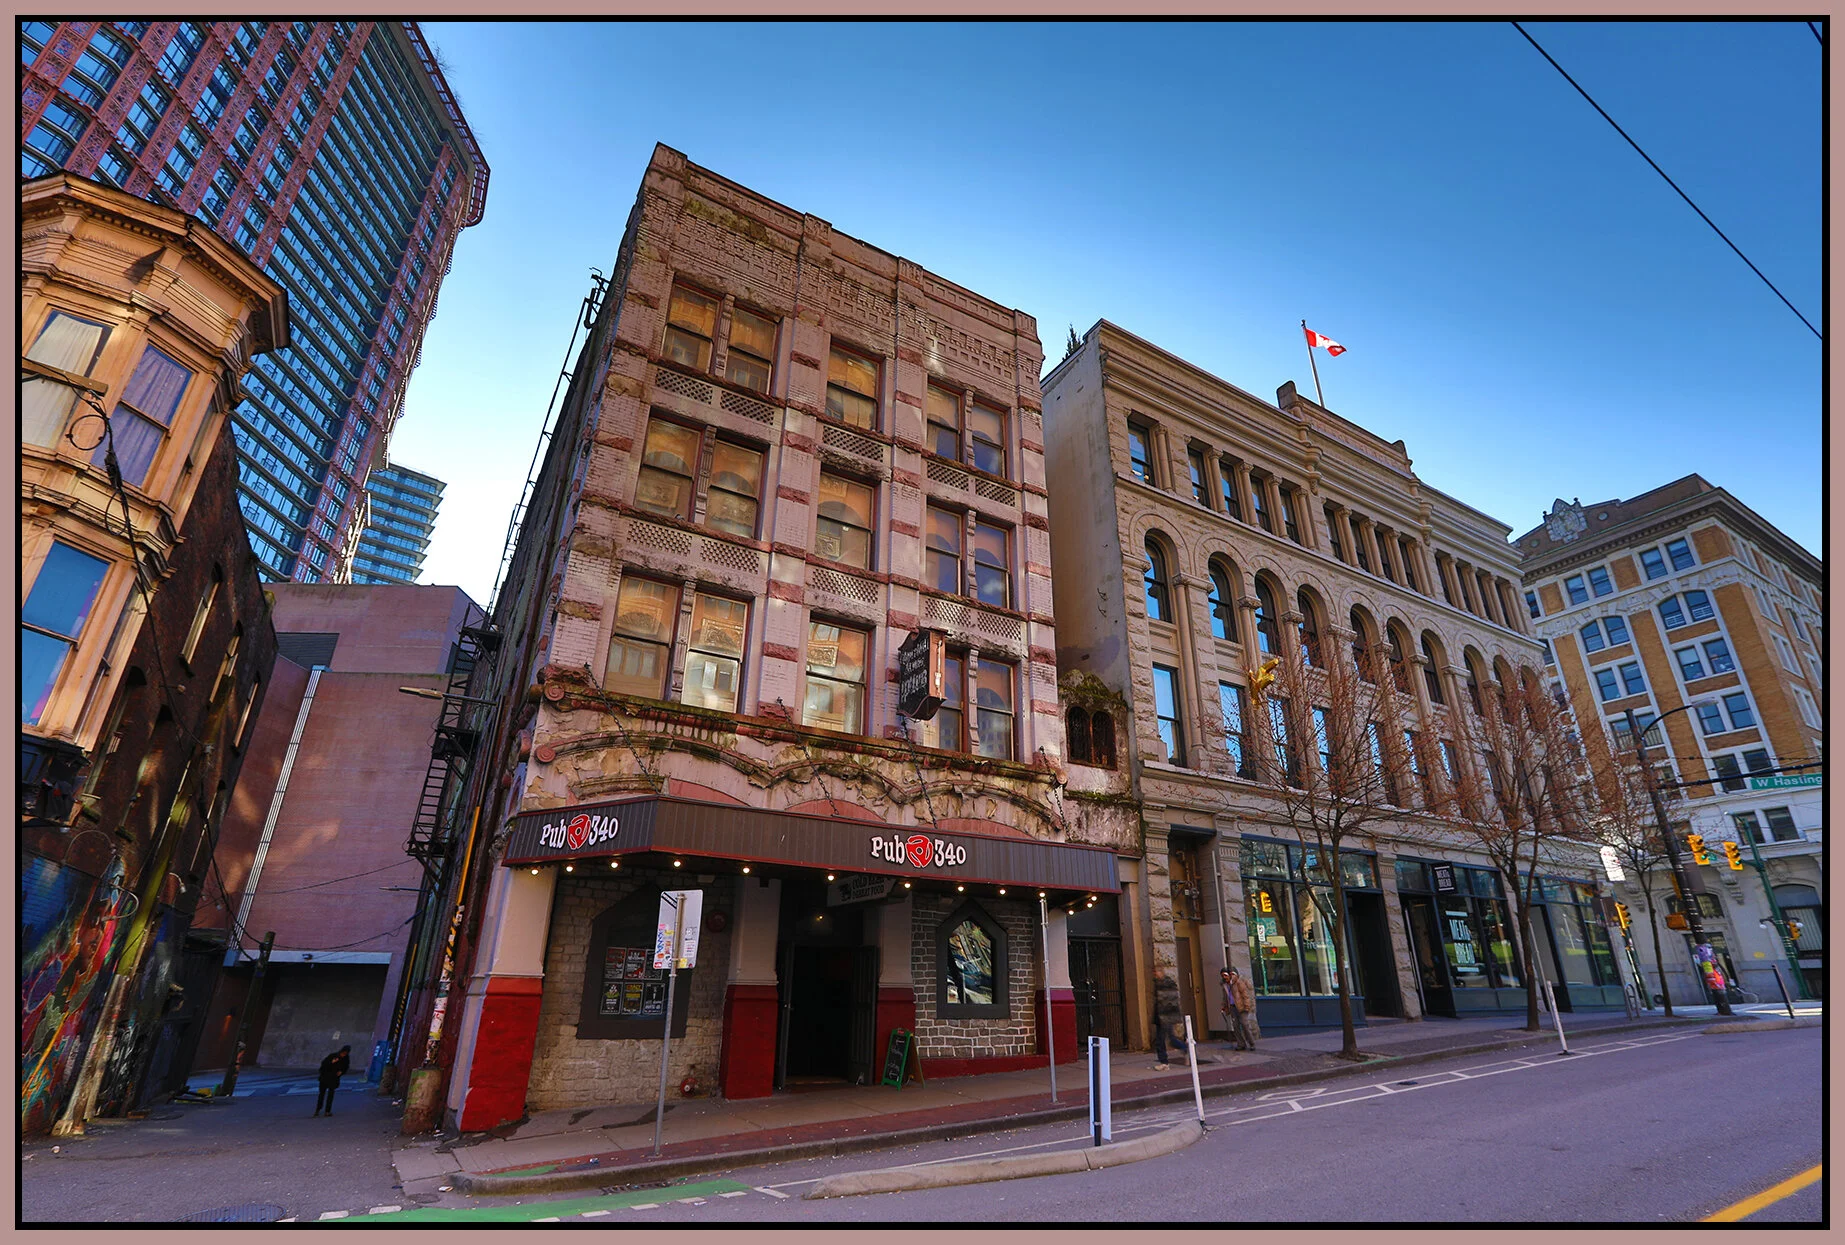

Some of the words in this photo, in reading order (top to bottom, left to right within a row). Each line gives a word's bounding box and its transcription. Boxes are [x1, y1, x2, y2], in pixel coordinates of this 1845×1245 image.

[1756, 778, 1769, 787] W
[1774, 776, 1822, 786] Hasting
[539, 818, 567, 849] Pub
[588, 815, 619, 846] 340
[871, 834, 906, 864] Pub
[934, 838, 967, 867] 340
